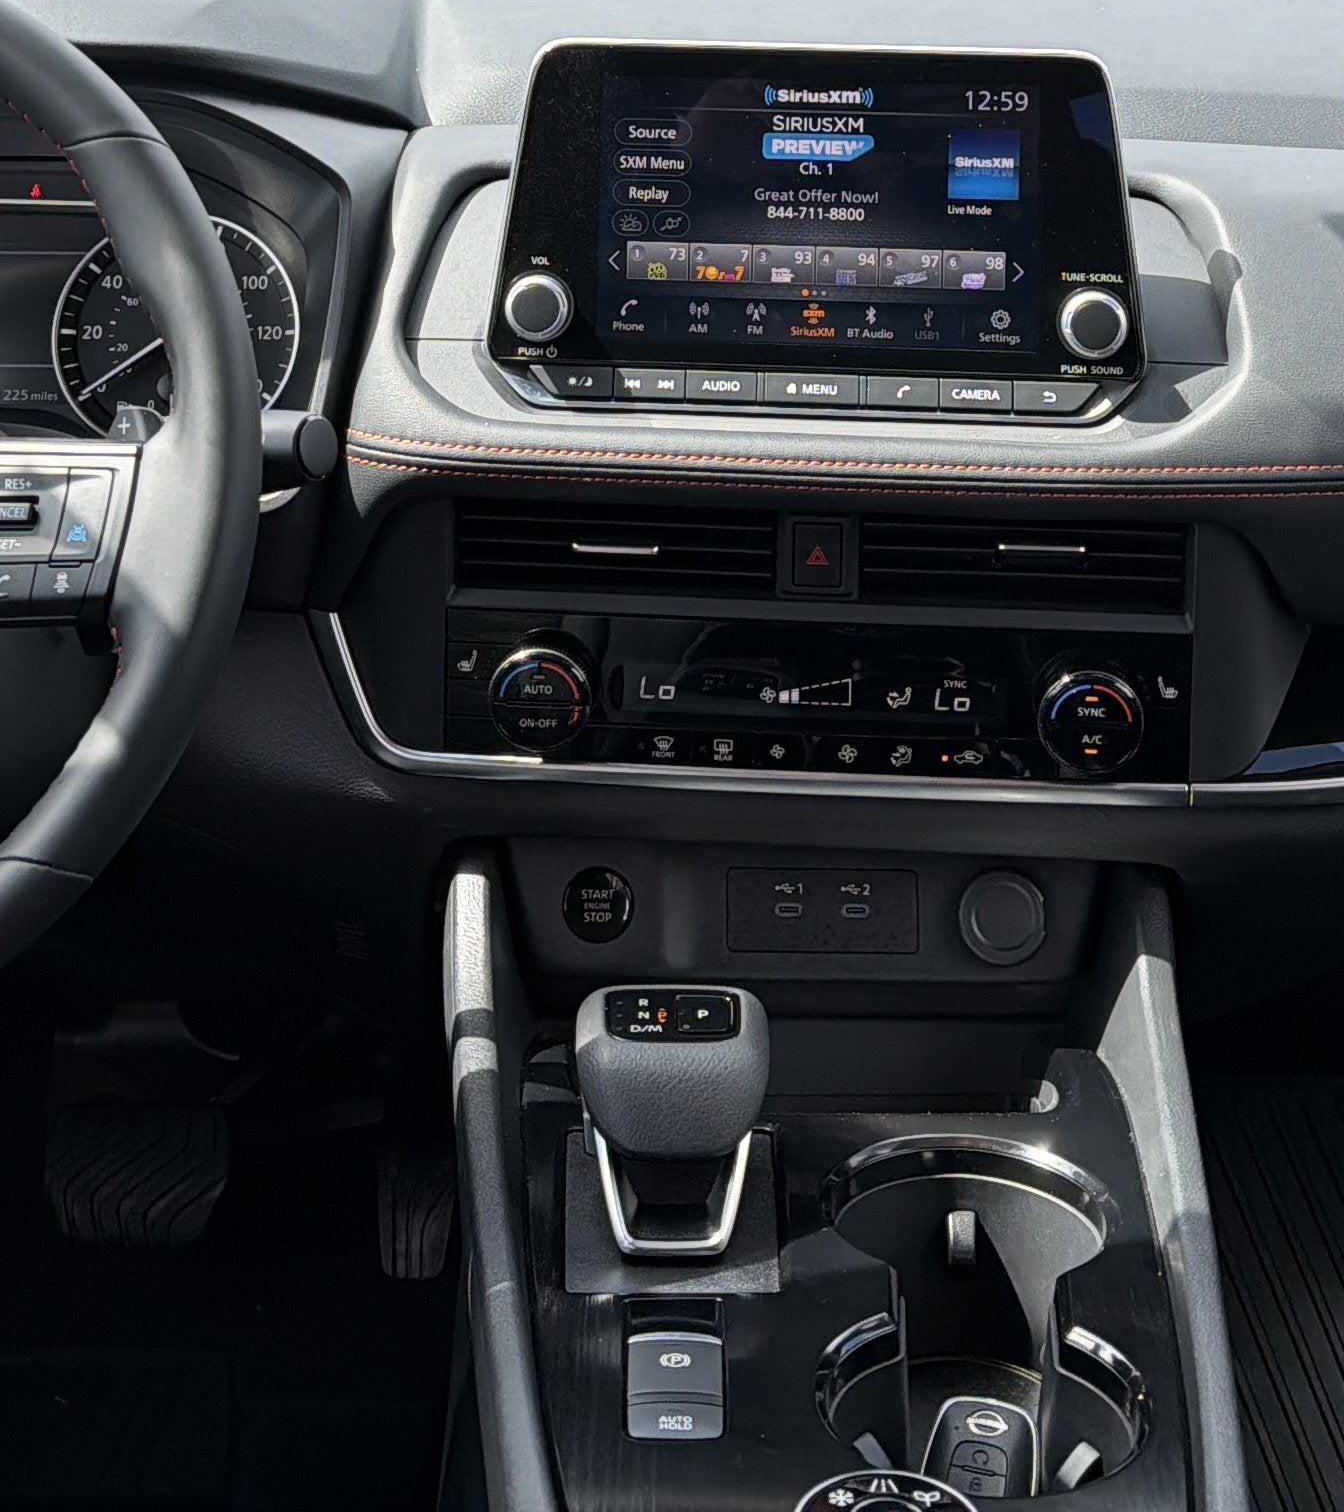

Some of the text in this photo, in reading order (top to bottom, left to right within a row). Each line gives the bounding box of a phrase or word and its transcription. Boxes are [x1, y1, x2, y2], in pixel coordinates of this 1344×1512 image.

[964, 90, 1029, 113] 12:59
[771, 114, 865, 134] SIRIUSXM
[627, 124, 677, 140] Source
[770, 138, 866, 157] PREVIEW
[619, 155, 685, 171] SXM Menu
[954, 156, 1015, 169] SiriusXM
[798, 162, 833, 177] Ch. 1
[627, 186, 670, 204] Replay
[753, 187, 879, 205] Great Offer Now!
[766, 205, 866, 222] 844-711-8800
[948, 204, 993, 217] Live Mode
[529, 256, 549, 266] VOL
[633, 247, 687, 262] 1 73
[695, 249, 750, 262] 2 7
[758, 251, 813, 265] 3 93
[821, 253, 876, 267] 4 94
[885, 255, 940, 269] 5 97
[949, 256, 1004, 271] 6 98
[100, 274, 123, 290] 40
[240, 275, 269, 290] 100
[126, 298, 139, 307] 60
[81, 324, 103, 340] 20
[257, 325, 283, 340] 120
[612, 319, 645, 334] Phone
[688, 323, 708, 334] AM
[747, 325, 764, 336] FM
[789, 325, 835, 338] SiriusXM
[846, 327, 894, 340] BT Audio
[914, 329, 940, 341] USB1
[978, 331, 1022, 346] Settings
[116, 343, 129, 352] 20
[517, 346, 544, 356] PUSH
[1060, 364, 1124, 376] PUSH SOUND
[701, 378, 741, 393] AUDIO
[801, 382, 838, 397] MENU
[2, 388, 29, 402] 225
[30, 390, 58, 402] miles
[951, 388, 1001, 403] CAMERA
[3, 477, 33, 490] RES+
[523, 683, 554, 696] AUTO
[638, 675, 676, 701] Lo
[943, 679, 968, 690] SYNC
[933, 688, 972, 714] Lo
[1076, 707, 1107, 718] SYNC
[1081, 734, 1104, 746] A/C
[650, 751, 677, 760] FRONT
[712, 753, 735, 762] REAR
[580, 889, 615, 900] START
[796, 883, 803, 894] 1
[862, 884, 870, 896] 2
[583, 902, 611, 910] ENGINE
[582, 911, 613, 923] STOP
[638, 998, 649, 1007] R
[637, 1011, 650, 1020] N
[697, 1009, 710, 1020] P
[629, 1024, 663, 1033] D/M
[658, 1415, 693, 1423] AUTO
[658, 1423, 693, 1431] HOLD
